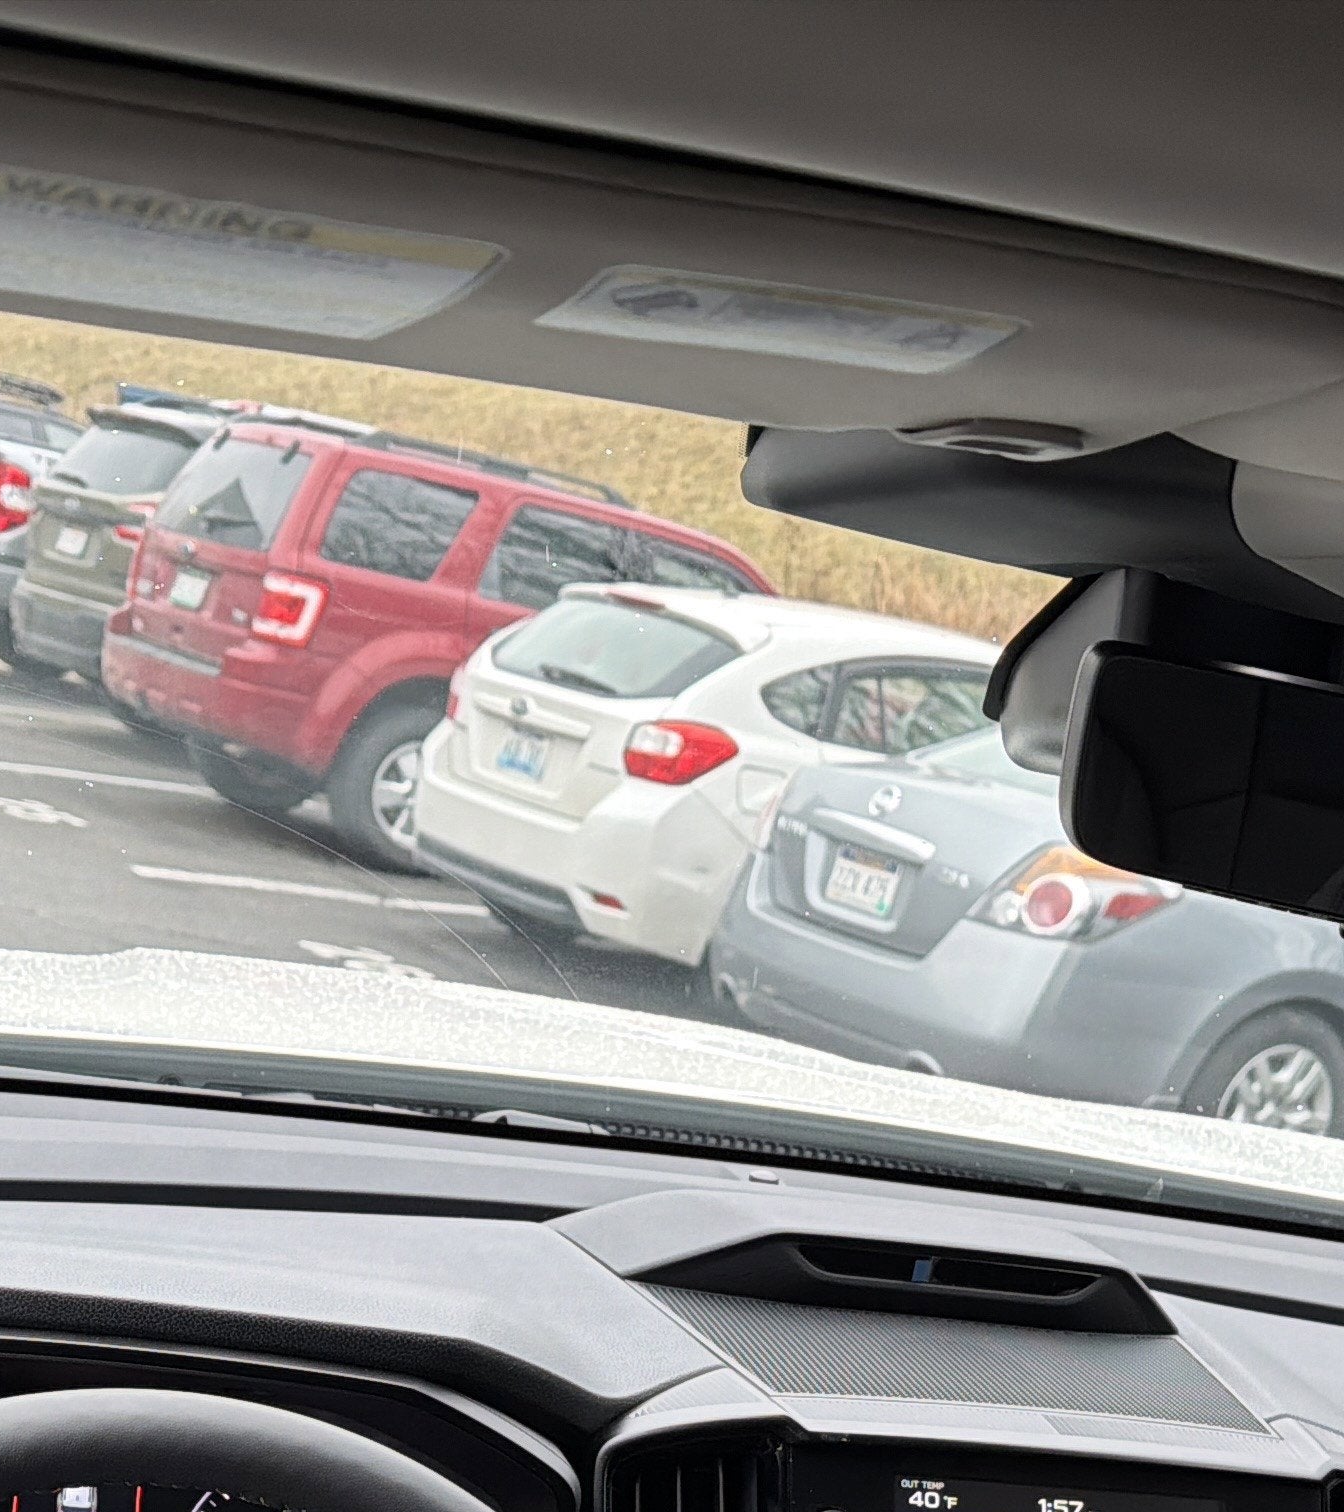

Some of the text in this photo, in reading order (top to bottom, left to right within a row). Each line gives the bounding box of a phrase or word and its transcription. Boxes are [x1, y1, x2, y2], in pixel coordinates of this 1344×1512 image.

[901, 1479, 945, 1490] OUT TEMP
[908, 1491, 940, 1508] 40
